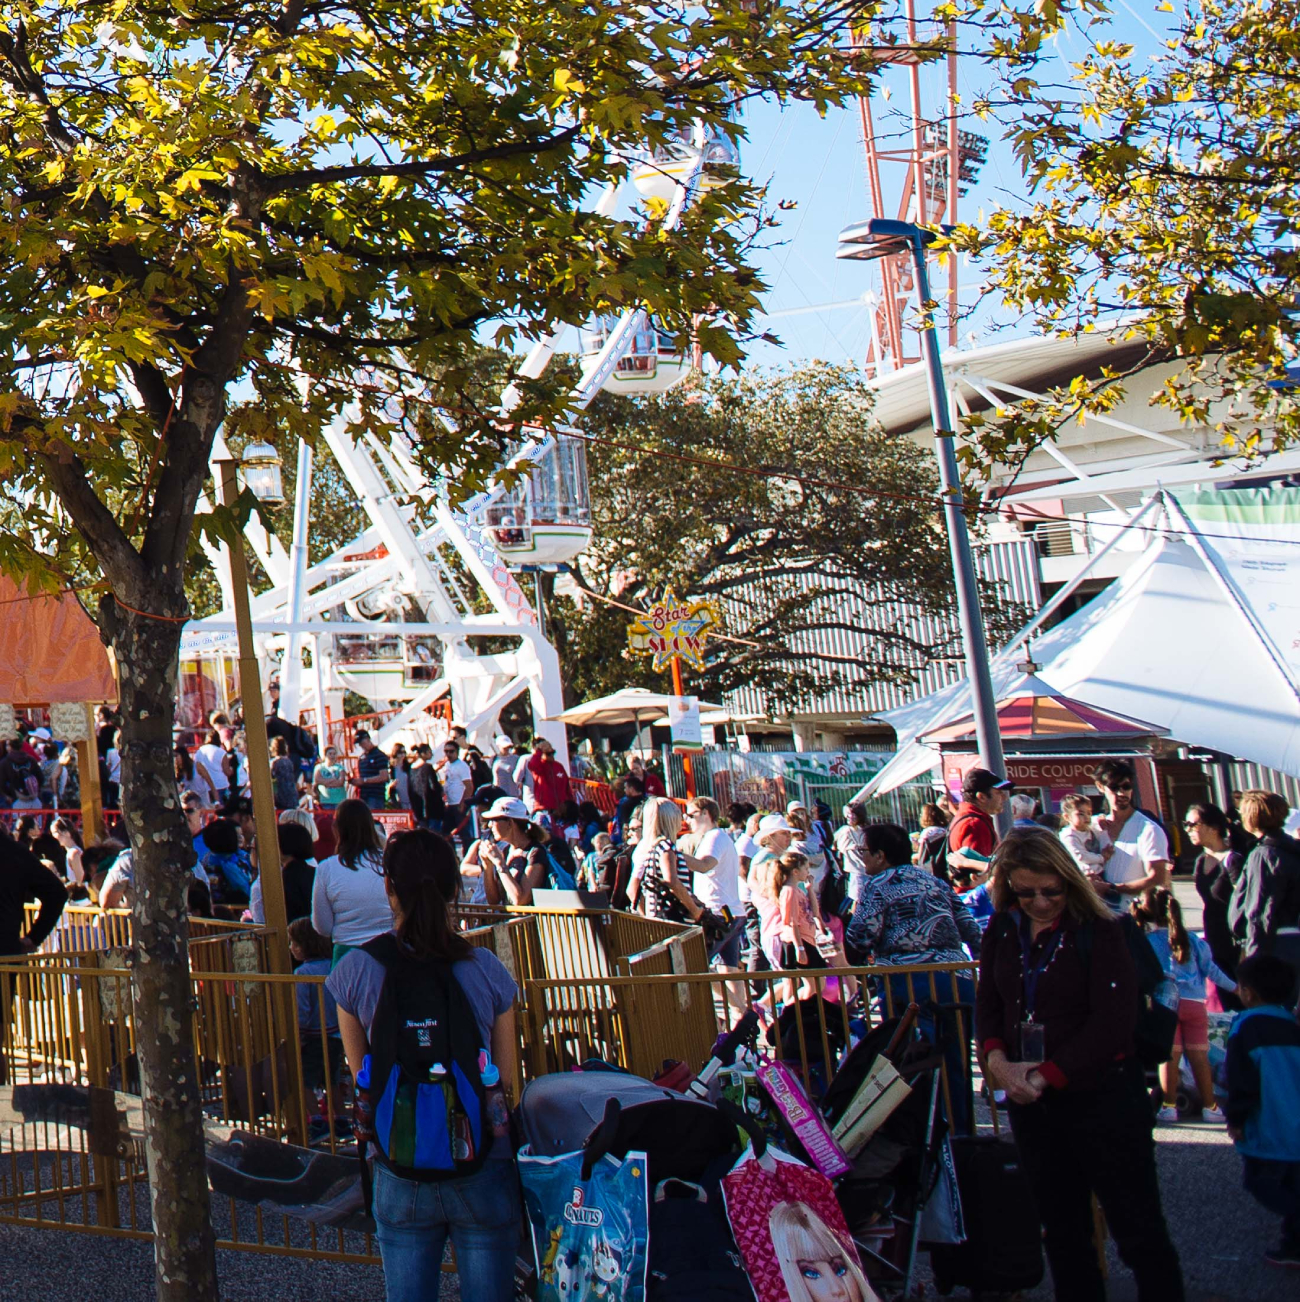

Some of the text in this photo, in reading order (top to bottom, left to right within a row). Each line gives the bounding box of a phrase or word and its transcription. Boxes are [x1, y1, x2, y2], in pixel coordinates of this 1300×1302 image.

[652, 607, 689, 630] Star
[683, 623, 697, 631] the
[1006, 764, 1098, 778] RIDE COUPO
